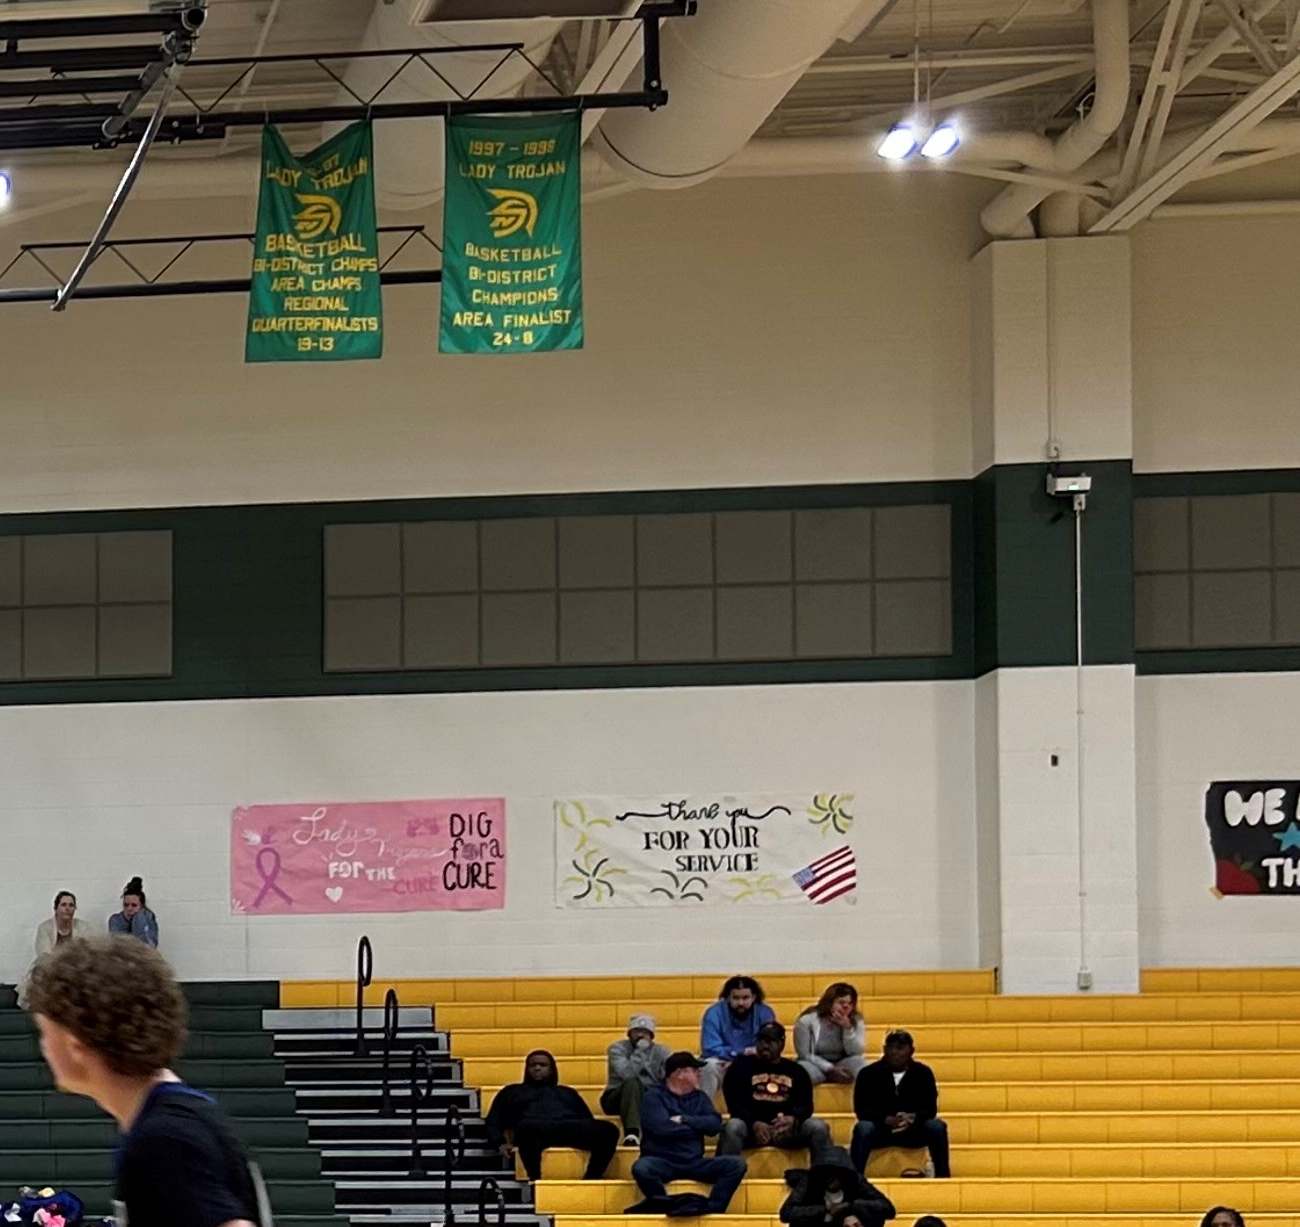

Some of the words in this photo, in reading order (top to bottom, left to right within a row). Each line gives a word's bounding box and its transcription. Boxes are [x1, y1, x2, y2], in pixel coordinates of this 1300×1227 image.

[460, 163, 496, 179] LADY
[507, 160, 566, 179] TROJAN
[469, 263, 557, 284] BI-DISTRICT
[284, 296, 349, 311] REGIONAL
[472, 287, 558, 305] CHAMPIONS
[453, 311, 494, 327] AREA
[503, 309, 572, 328] FINALIST
[1224, 787, 1287, 827] WE
[449, 812, 493, 837] DIG
[642, 830, 689, 851] FOR
[699, 825, 759, 850] YOUR
[675, 852, 759, 872] SERVICE
[365, 867, 397, 882] THE
[442, 861, 498, 891] CURE
[393, 875, 440, 895] CURE
